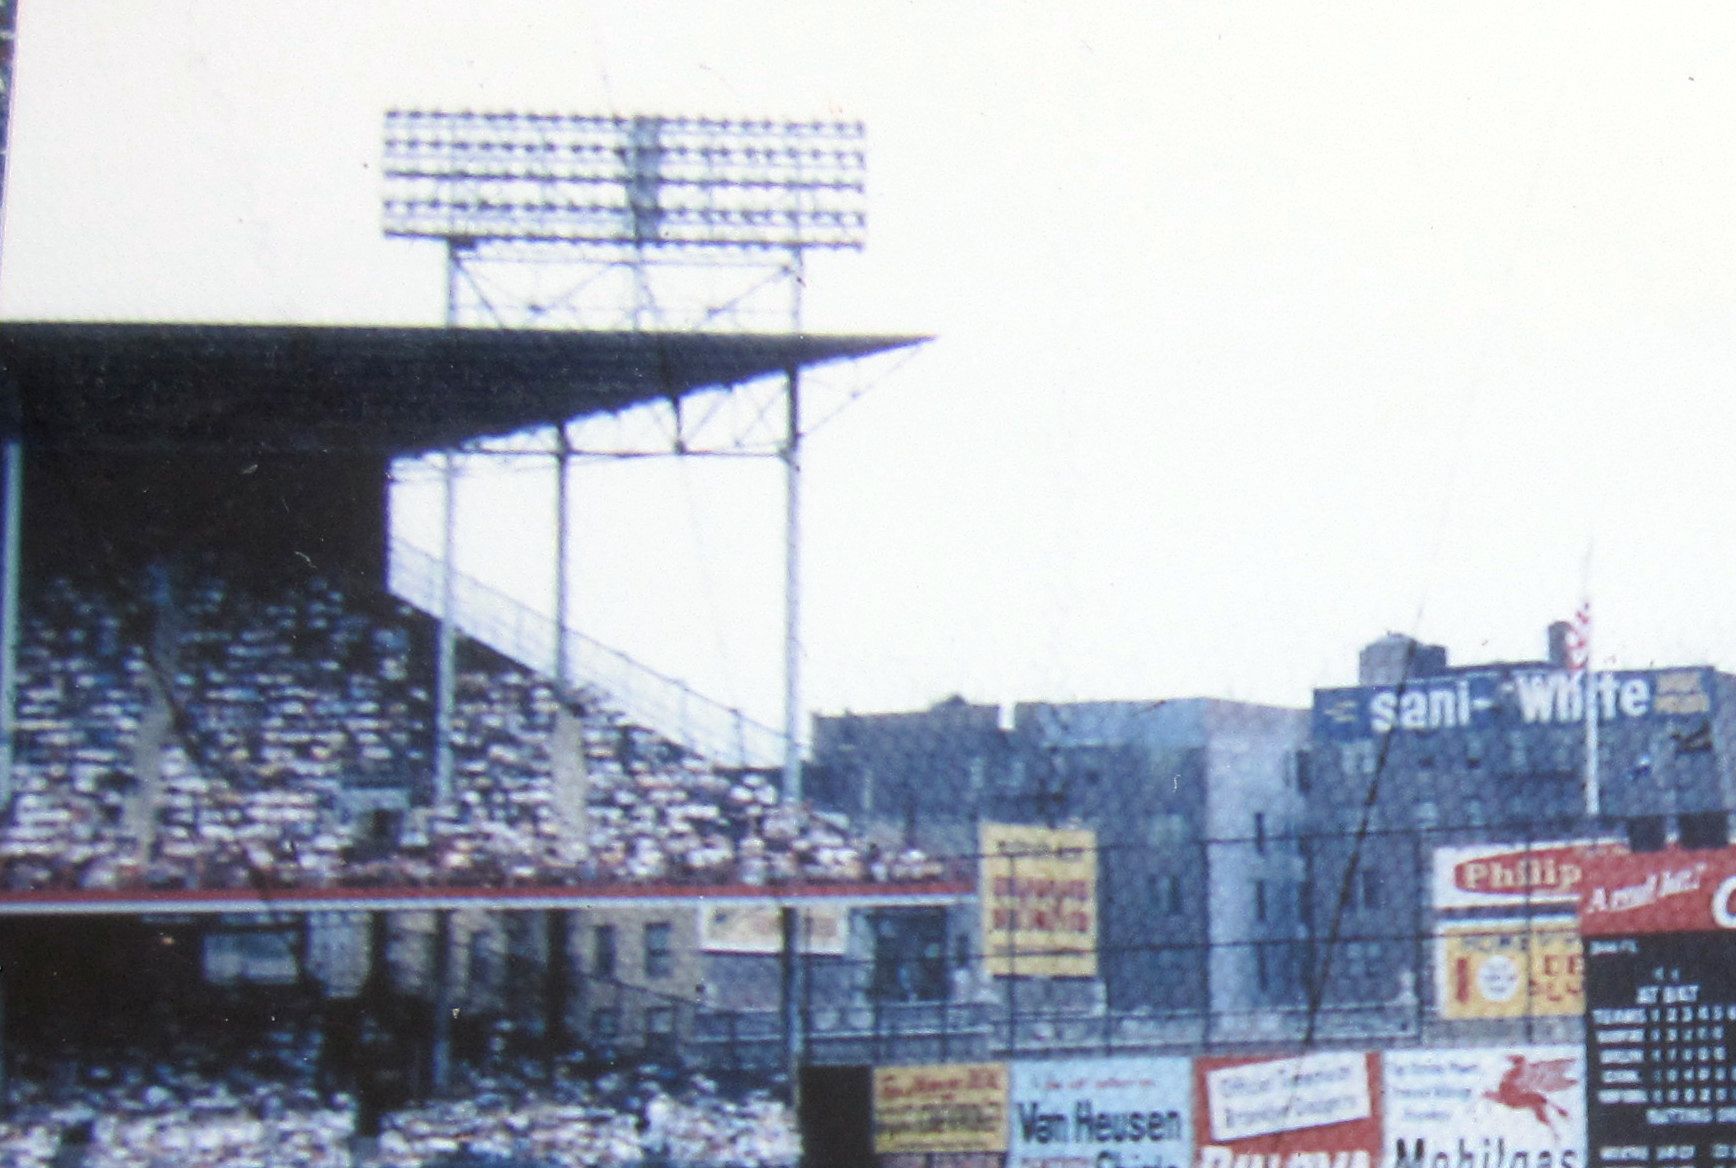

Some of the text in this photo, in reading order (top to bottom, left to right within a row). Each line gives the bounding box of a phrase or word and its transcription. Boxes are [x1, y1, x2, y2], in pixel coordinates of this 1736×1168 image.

[1517, 672, 1650, 722] Whte
[1016, 1101, 1070, 1143] Van
[1073, 1099, 1182, 1143] Heusen
